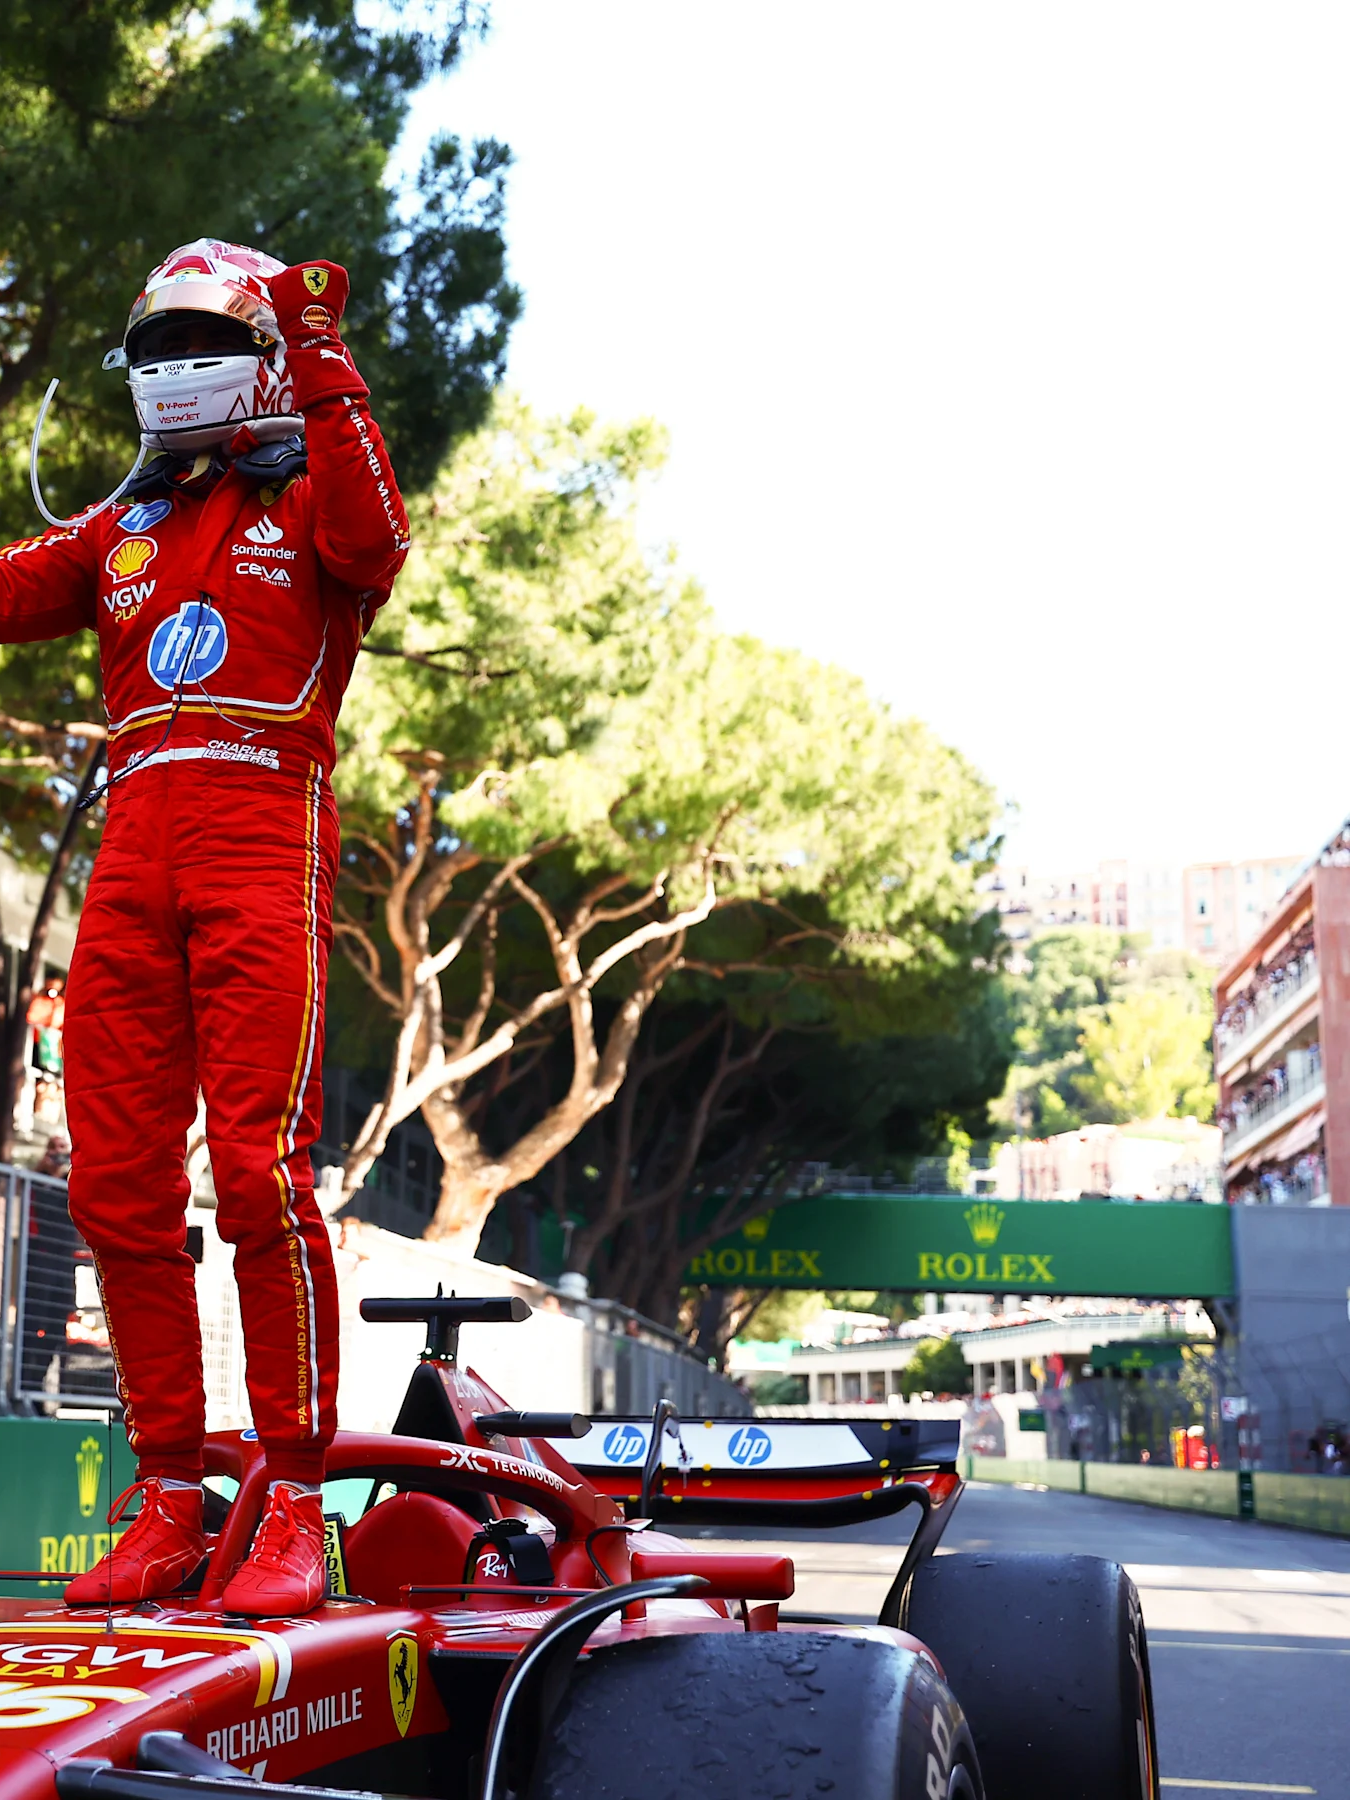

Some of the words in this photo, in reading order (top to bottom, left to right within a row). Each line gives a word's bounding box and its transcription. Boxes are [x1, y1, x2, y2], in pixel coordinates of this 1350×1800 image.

[163, 363, 187, 372] VGW
[165, 401, 198, 410] V-Power
[350, 408, 382, 477] RICHARD
[377, 480, 398, 529] MILLE
[231, 544, 298, 560] Santander
[103, 580, 157, 613] VGW
[115, 602, 144, 623] PLAY
[151, 603, 225, 689] hp
[203, 749, 273, 767] LECLERC
[207, 739, 279, 758] CHARLES
[690, 1248, 824, 1278] ROLEX
[917, 1252, 1056, 1283] ROLEX
[285, 1232, 306, 1329] ACHIEVEMENT
[296, 1331, 306, 1362] AND
[297, 1364, 308, 1425] PASSION
[604, 1425, 646, 1464] hp
[728, 1427, 772, 1465] hp
[439, 1445, 489, 1473] DXC
[492, 1458, 565, 1493] TECHNOLOGY
[38, 1531, 126, 1587] ROLE
[206, 1706, 300, 1763] RICHARD
[306, 1687, 363, 1736] MILLE
